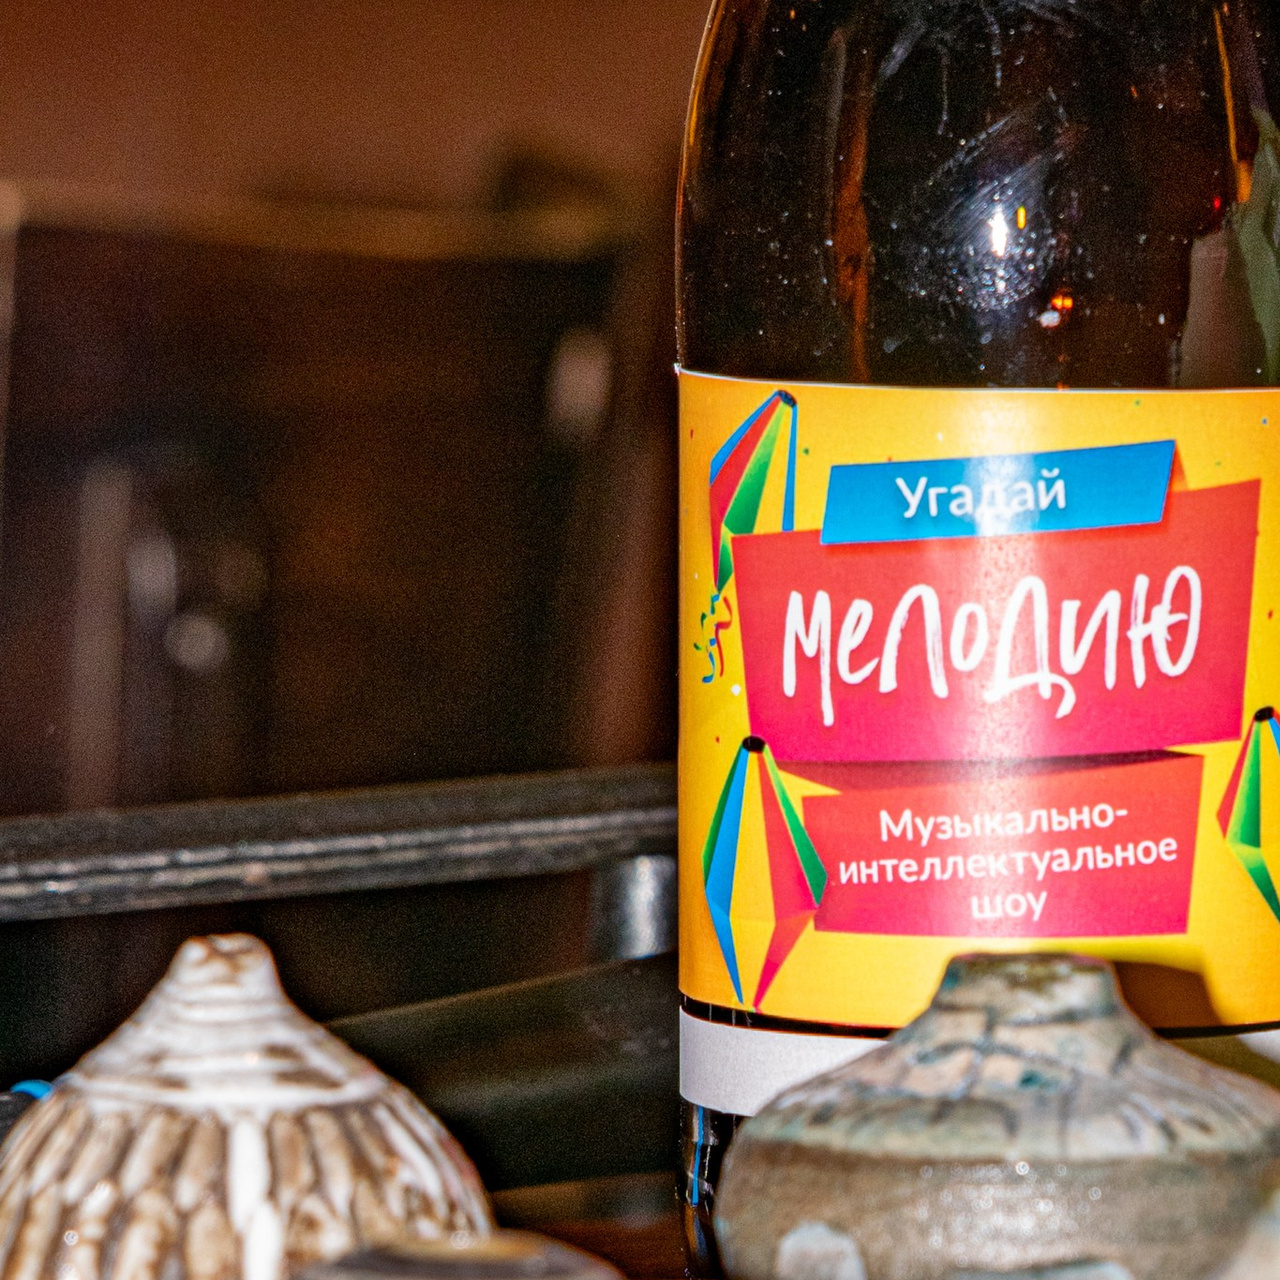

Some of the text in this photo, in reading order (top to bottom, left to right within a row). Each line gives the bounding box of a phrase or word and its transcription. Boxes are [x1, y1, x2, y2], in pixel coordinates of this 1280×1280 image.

[895, 468, 1067, 519] Угадай
[880, 801, 1128, 845] Музыкально-
[838, 835, 1178, 885] интеллектуальное
[970, 890, 1048, 923] шоу
